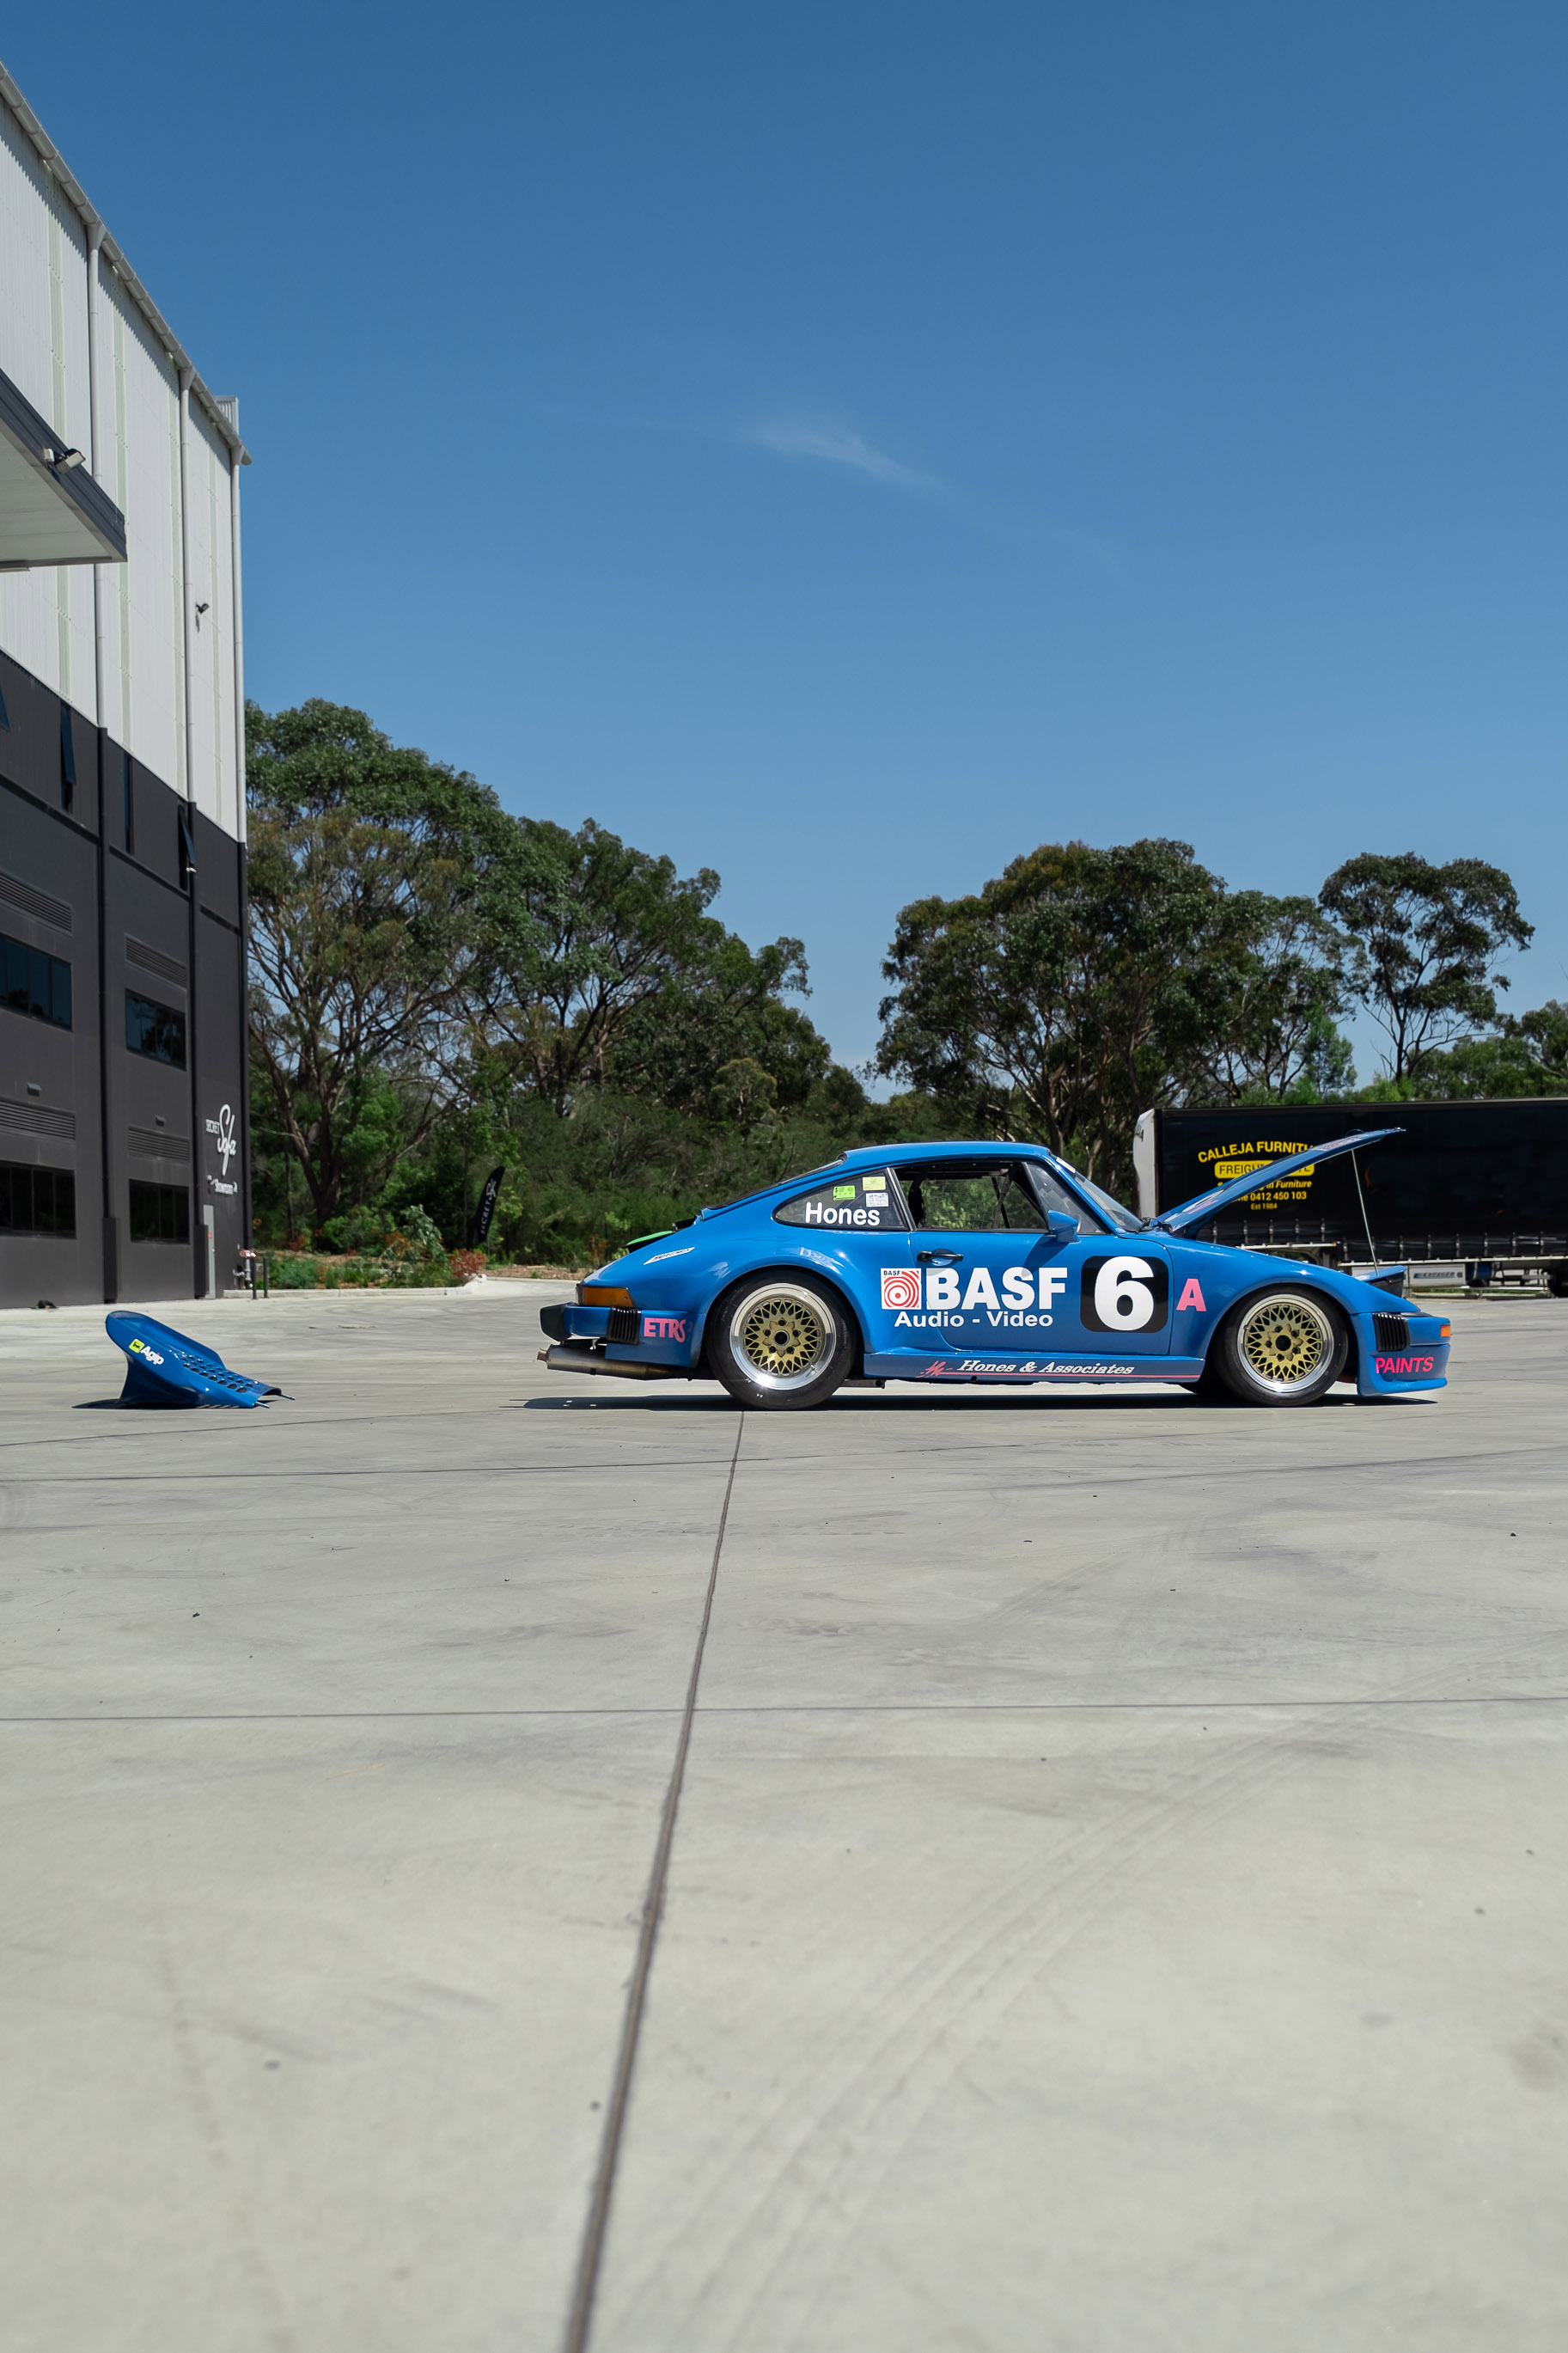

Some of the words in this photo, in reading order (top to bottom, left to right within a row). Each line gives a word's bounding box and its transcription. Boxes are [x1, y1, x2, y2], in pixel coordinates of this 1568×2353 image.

[1198, 1142, 1254, 1163] CALLEJA
[1220, 1164, 1263, 1175] FREIG
[1275, 1179, 1312, 1189] Furniture
[1250, 1192, 1272, 1201] 0412
[1272, 1191, 1290, 1201] 450
[1290, 1190, 1307, 1200] 103
[805, 1201, 881, 1226] Hones
[925, 1267, 1068, 1310] BASF
[1095, 1256, 1154, 1331] 6
[1175, 1278, 1207, 1311] A
[894, 1311, 964, 1328] Audio
[986, 1311, 1053, 1327] Video
[140, 1345, 164, 1365] Agip
[957, 1360, 1016, 1372] Hones
[1019, 1361, 1037, 1373] &
[1038, 1363, 1135, 1375] Associates
[1376, 1356, 1434, 1374] PAINTS
